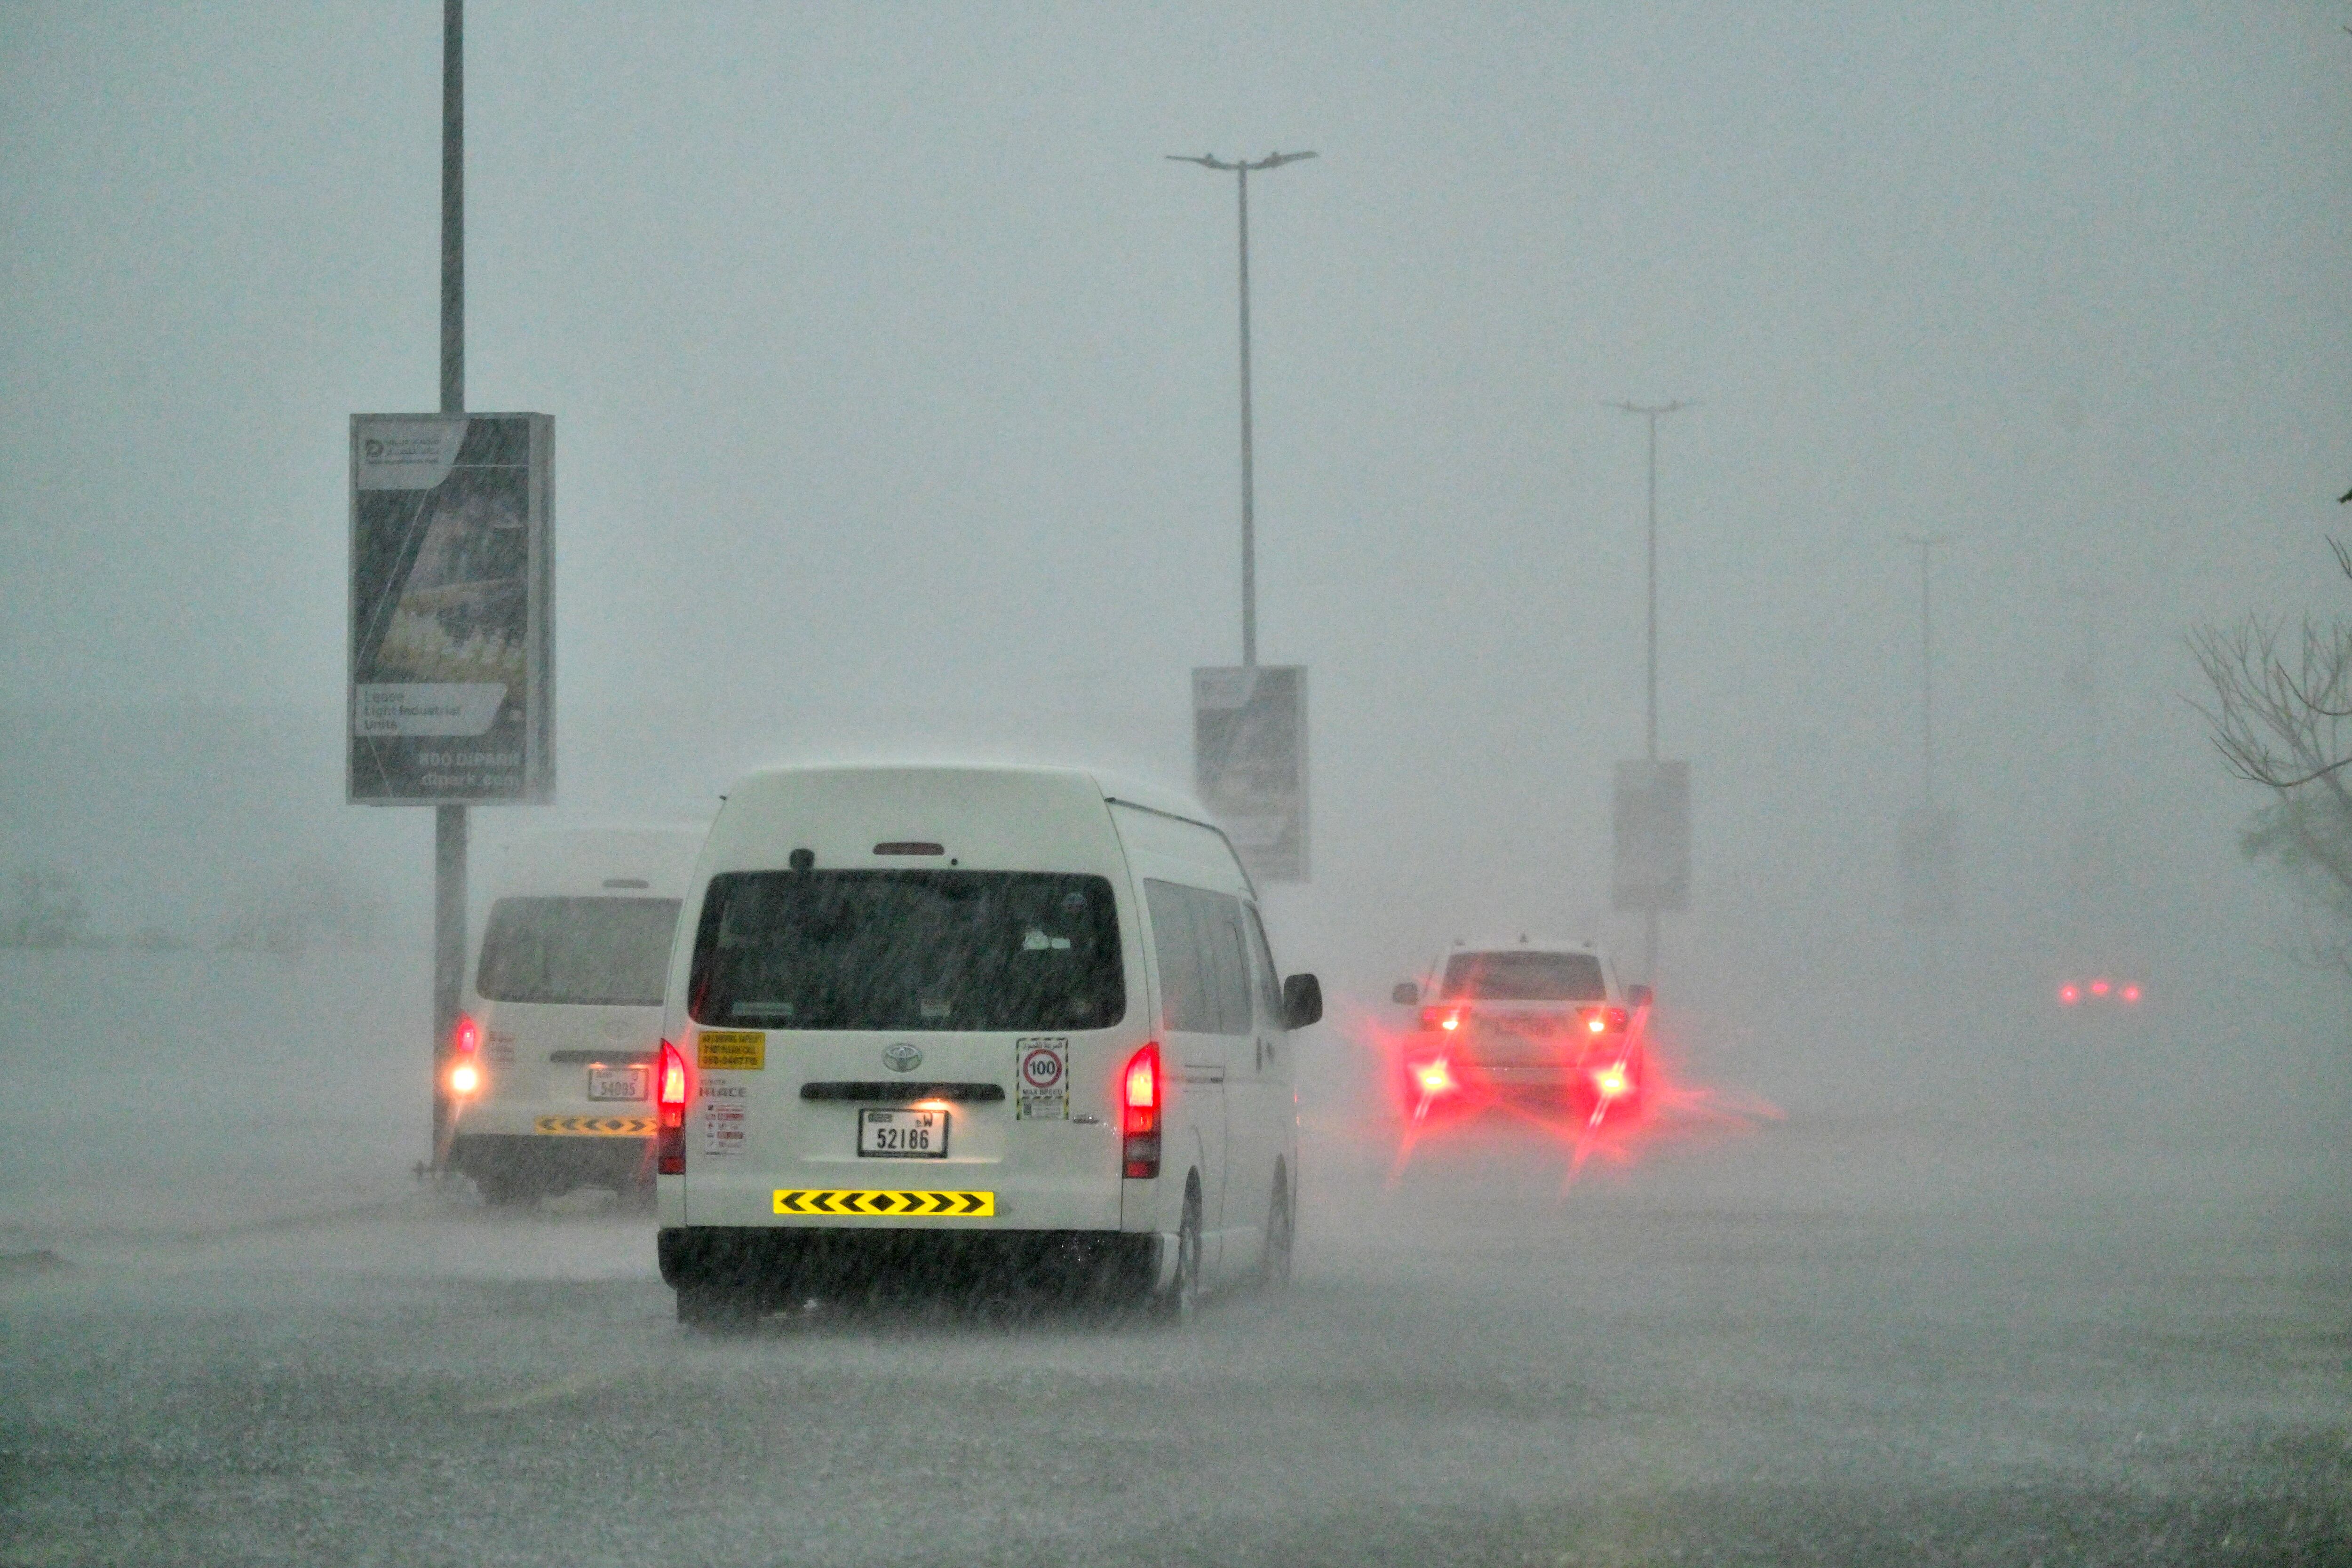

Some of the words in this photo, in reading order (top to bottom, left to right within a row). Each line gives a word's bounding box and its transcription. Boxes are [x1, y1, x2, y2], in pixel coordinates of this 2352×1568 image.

[1029, 1061, 1055, 1075] 100
[699, 1087, 747, 1097] HIACE
[923, 1113, 932, 1127] W
[877, 1128, 929, 1149] 52186
